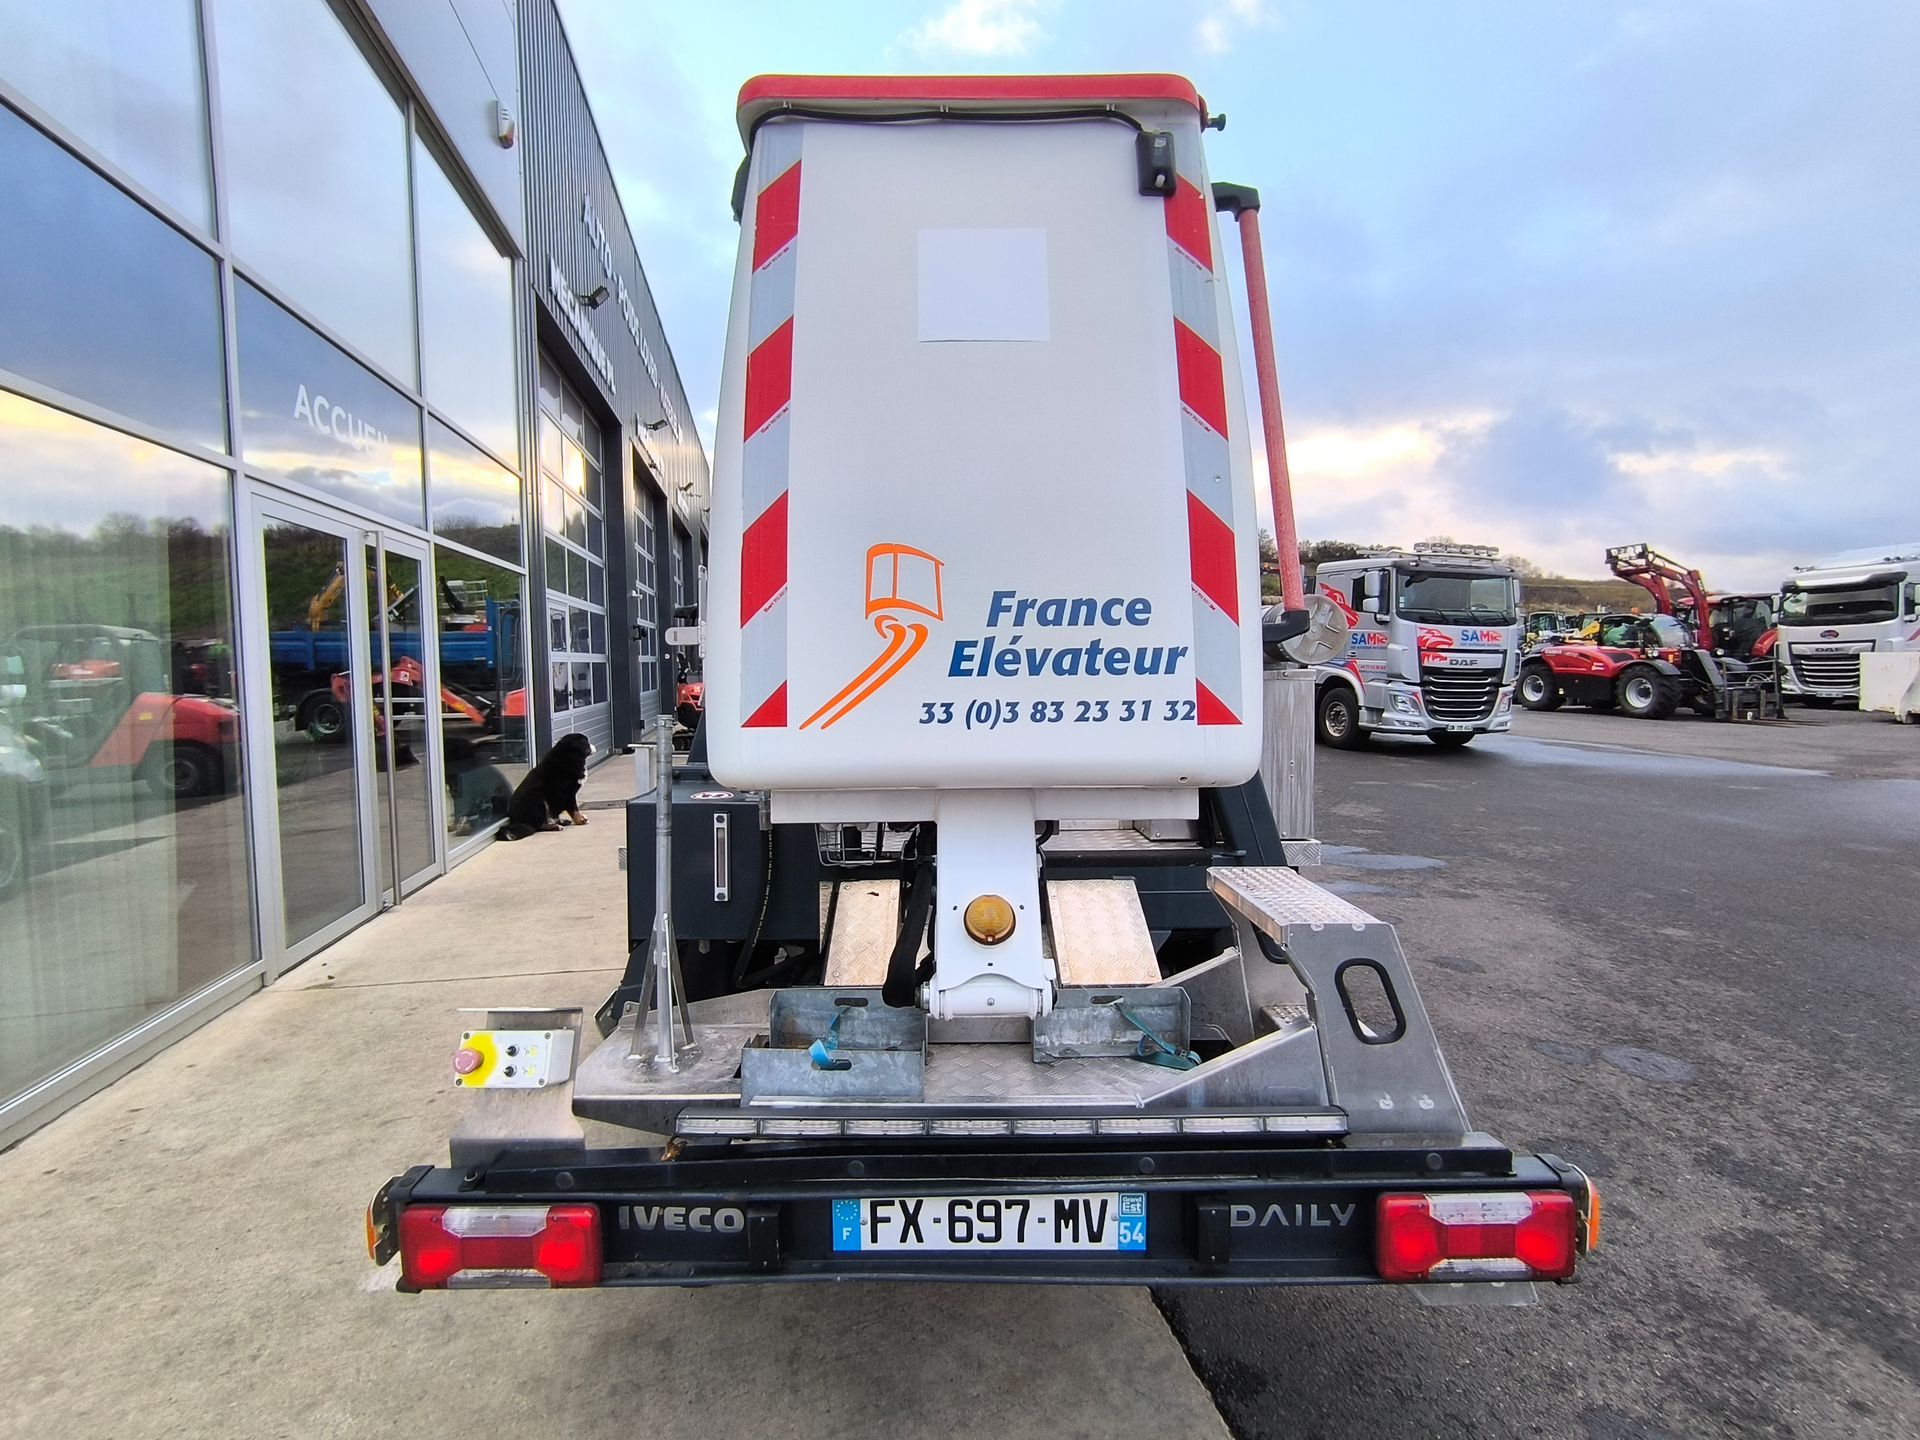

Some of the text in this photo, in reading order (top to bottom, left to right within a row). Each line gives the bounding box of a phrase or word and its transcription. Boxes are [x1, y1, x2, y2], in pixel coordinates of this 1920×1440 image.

[583, 193, 612, 280] AUTO
[985, 590, 1152, 628] France
[947, 635, 1189, 678] Elévateur
[1450, 658, 1479, 667] DAF
[919, 699, 1196, 730] 33 (0)3 83 23 31 32
[1122, 1196, 1142, 1204] Grand
[1122, 1202, 1142, 1212] Est
[617, 1204, 746, 1234] IVECO
[843, 1197, 1109, 1245] F FX-697-MV
[1230, 1203, 1357, 1228] DAILY
[1119, 1221, 1144, 1243] 54
